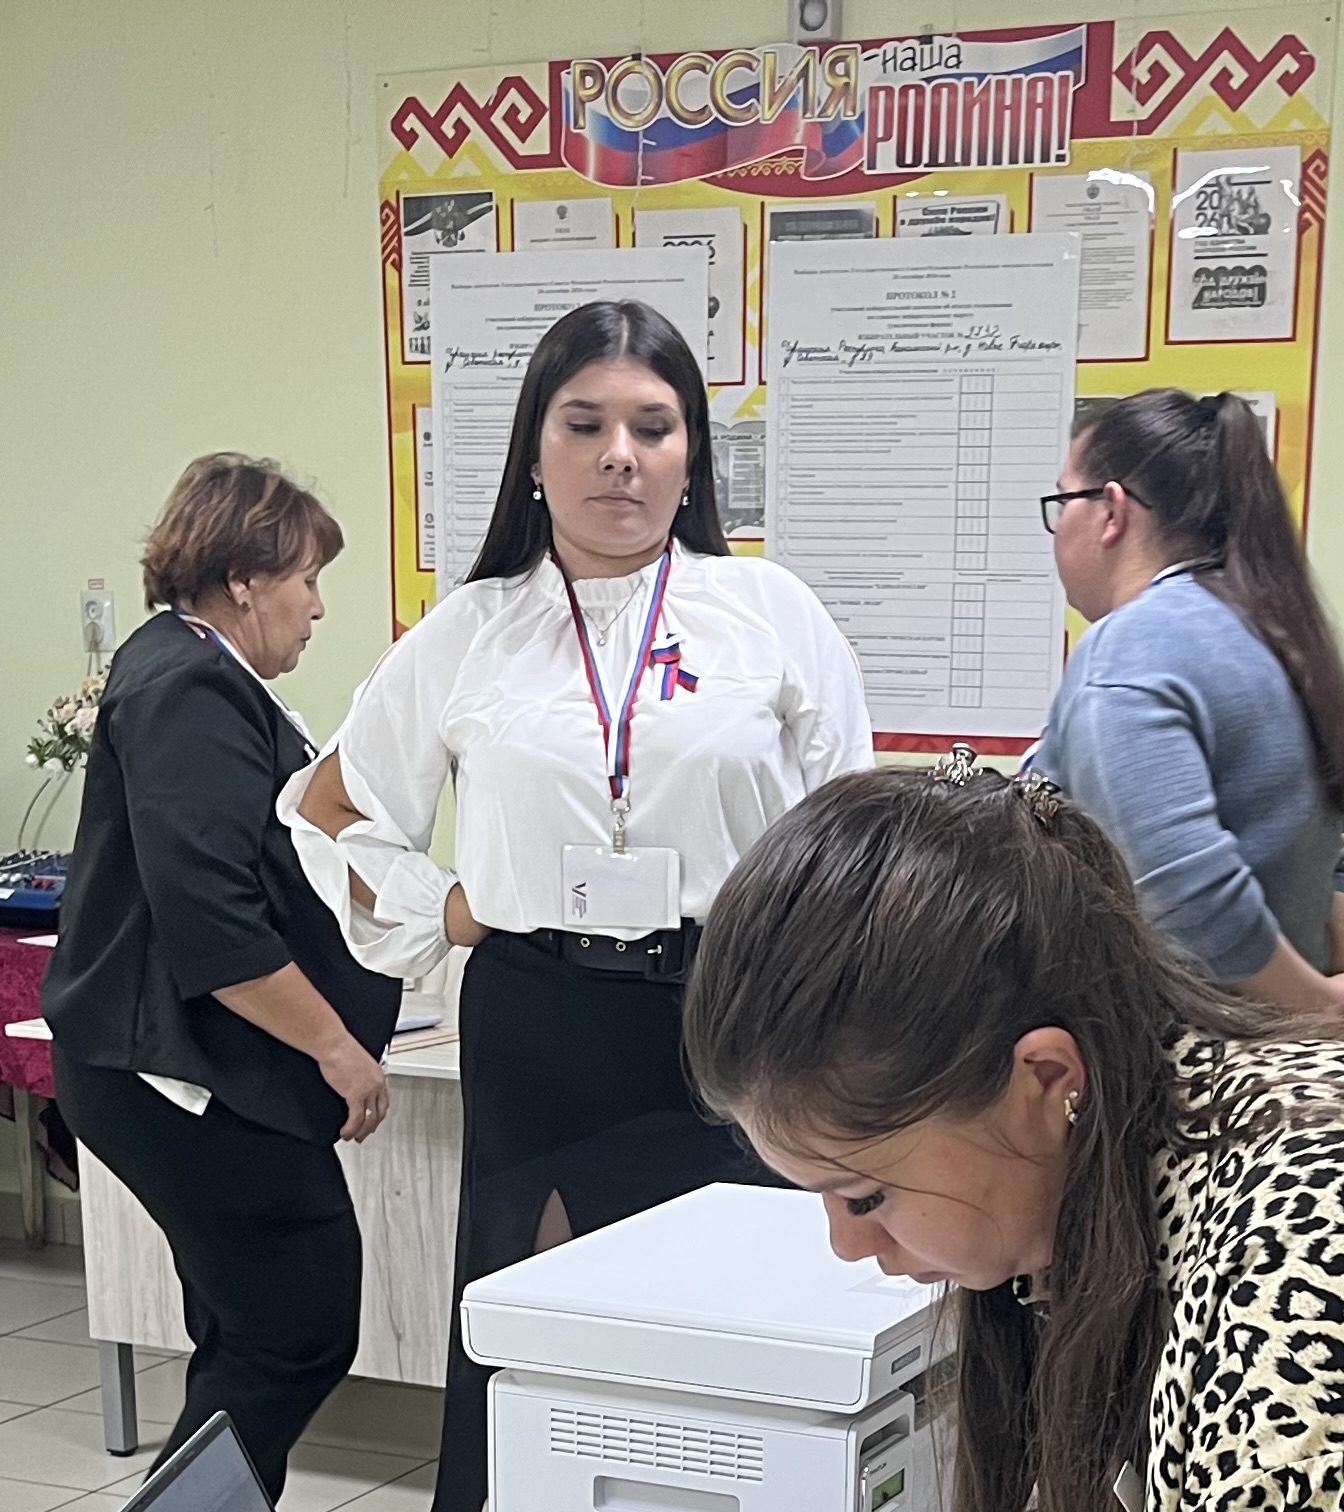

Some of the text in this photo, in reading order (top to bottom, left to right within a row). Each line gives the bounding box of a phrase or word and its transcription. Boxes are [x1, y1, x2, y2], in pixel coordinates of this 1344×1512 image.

[571, 47, 859, 132] РОССИЯ
[866, 74, 1071, 171] РОДИНА!
[1196, 189, 1221, 211] 20
